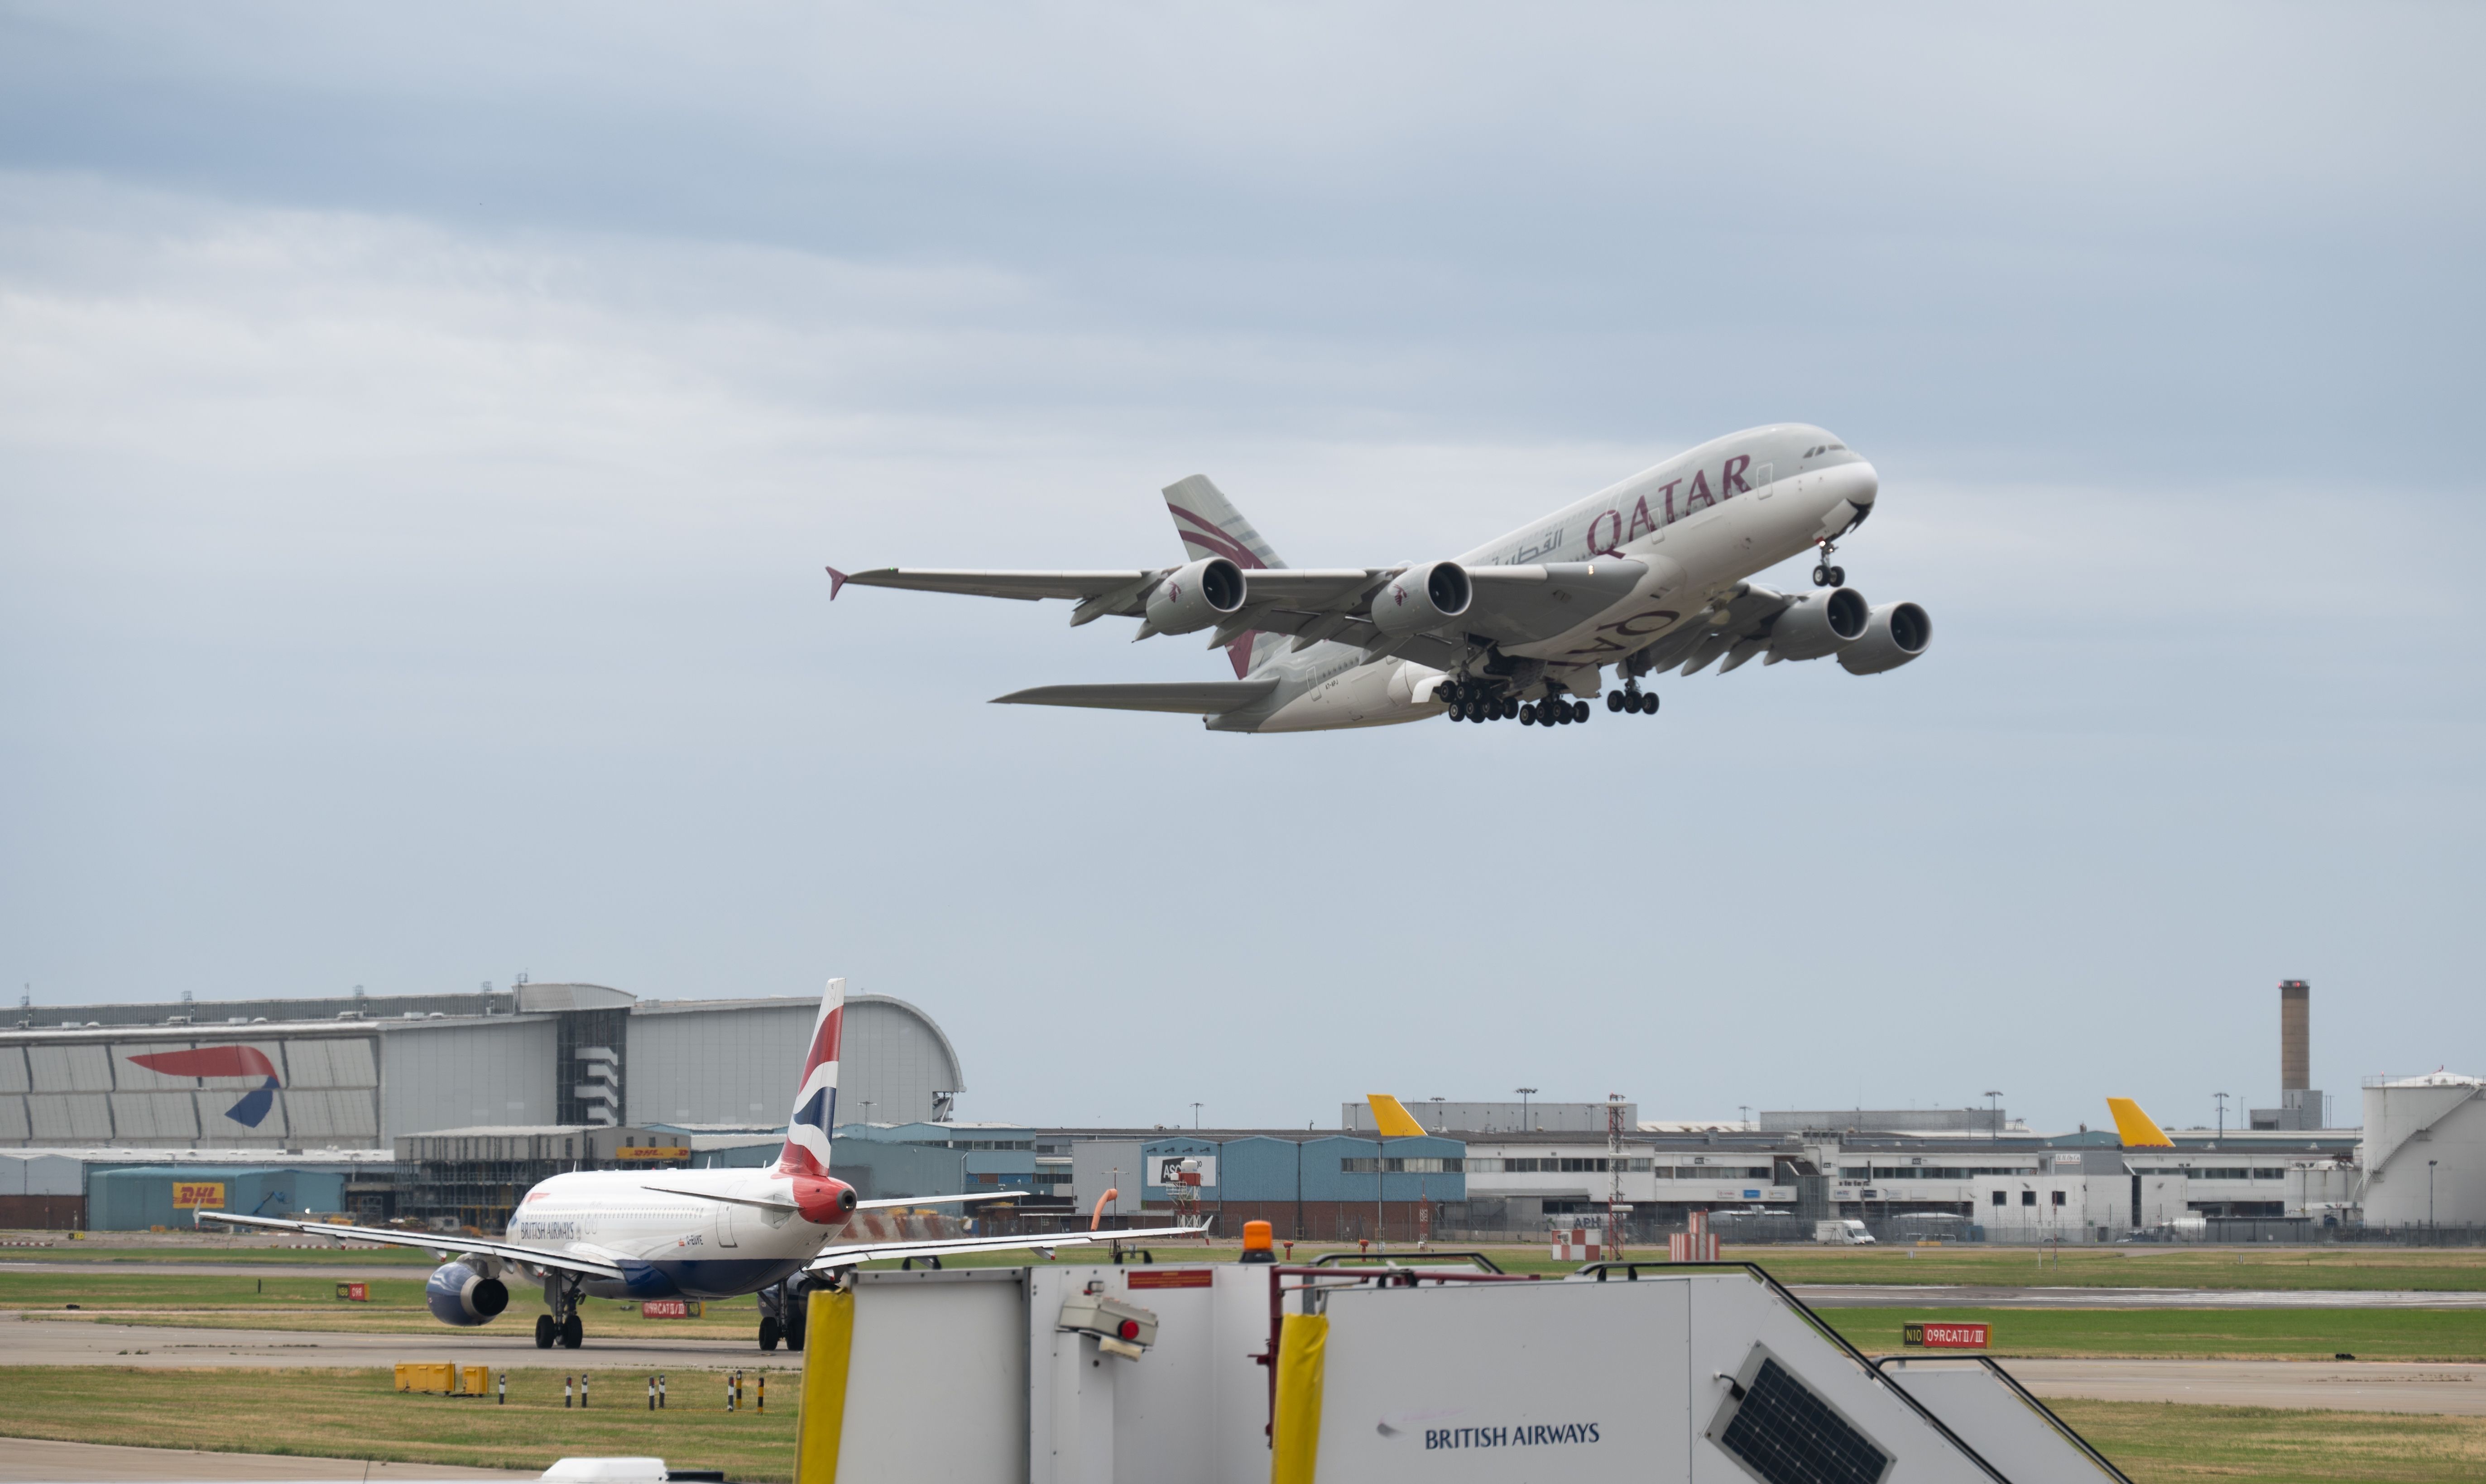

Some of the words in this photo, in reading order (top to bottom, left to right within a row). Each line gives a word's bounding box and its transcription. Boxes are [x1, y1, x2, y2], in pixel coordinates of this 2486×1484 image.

[1588, 455, 1752, 559] QATAR
[181, 1187, 217, 1204] DHL
[521, 1222, 545, 1240] BRITISH
[547, 1222, 574, 1240] AIRWAYS
[351, 1287, 363, 1297] 09R
[1906, 1330, 1922, 1341] N10
[1425, 1427, 1507, 1450] BRITISH
[1512, 1423, 1599, 1446] AIRWAYS
